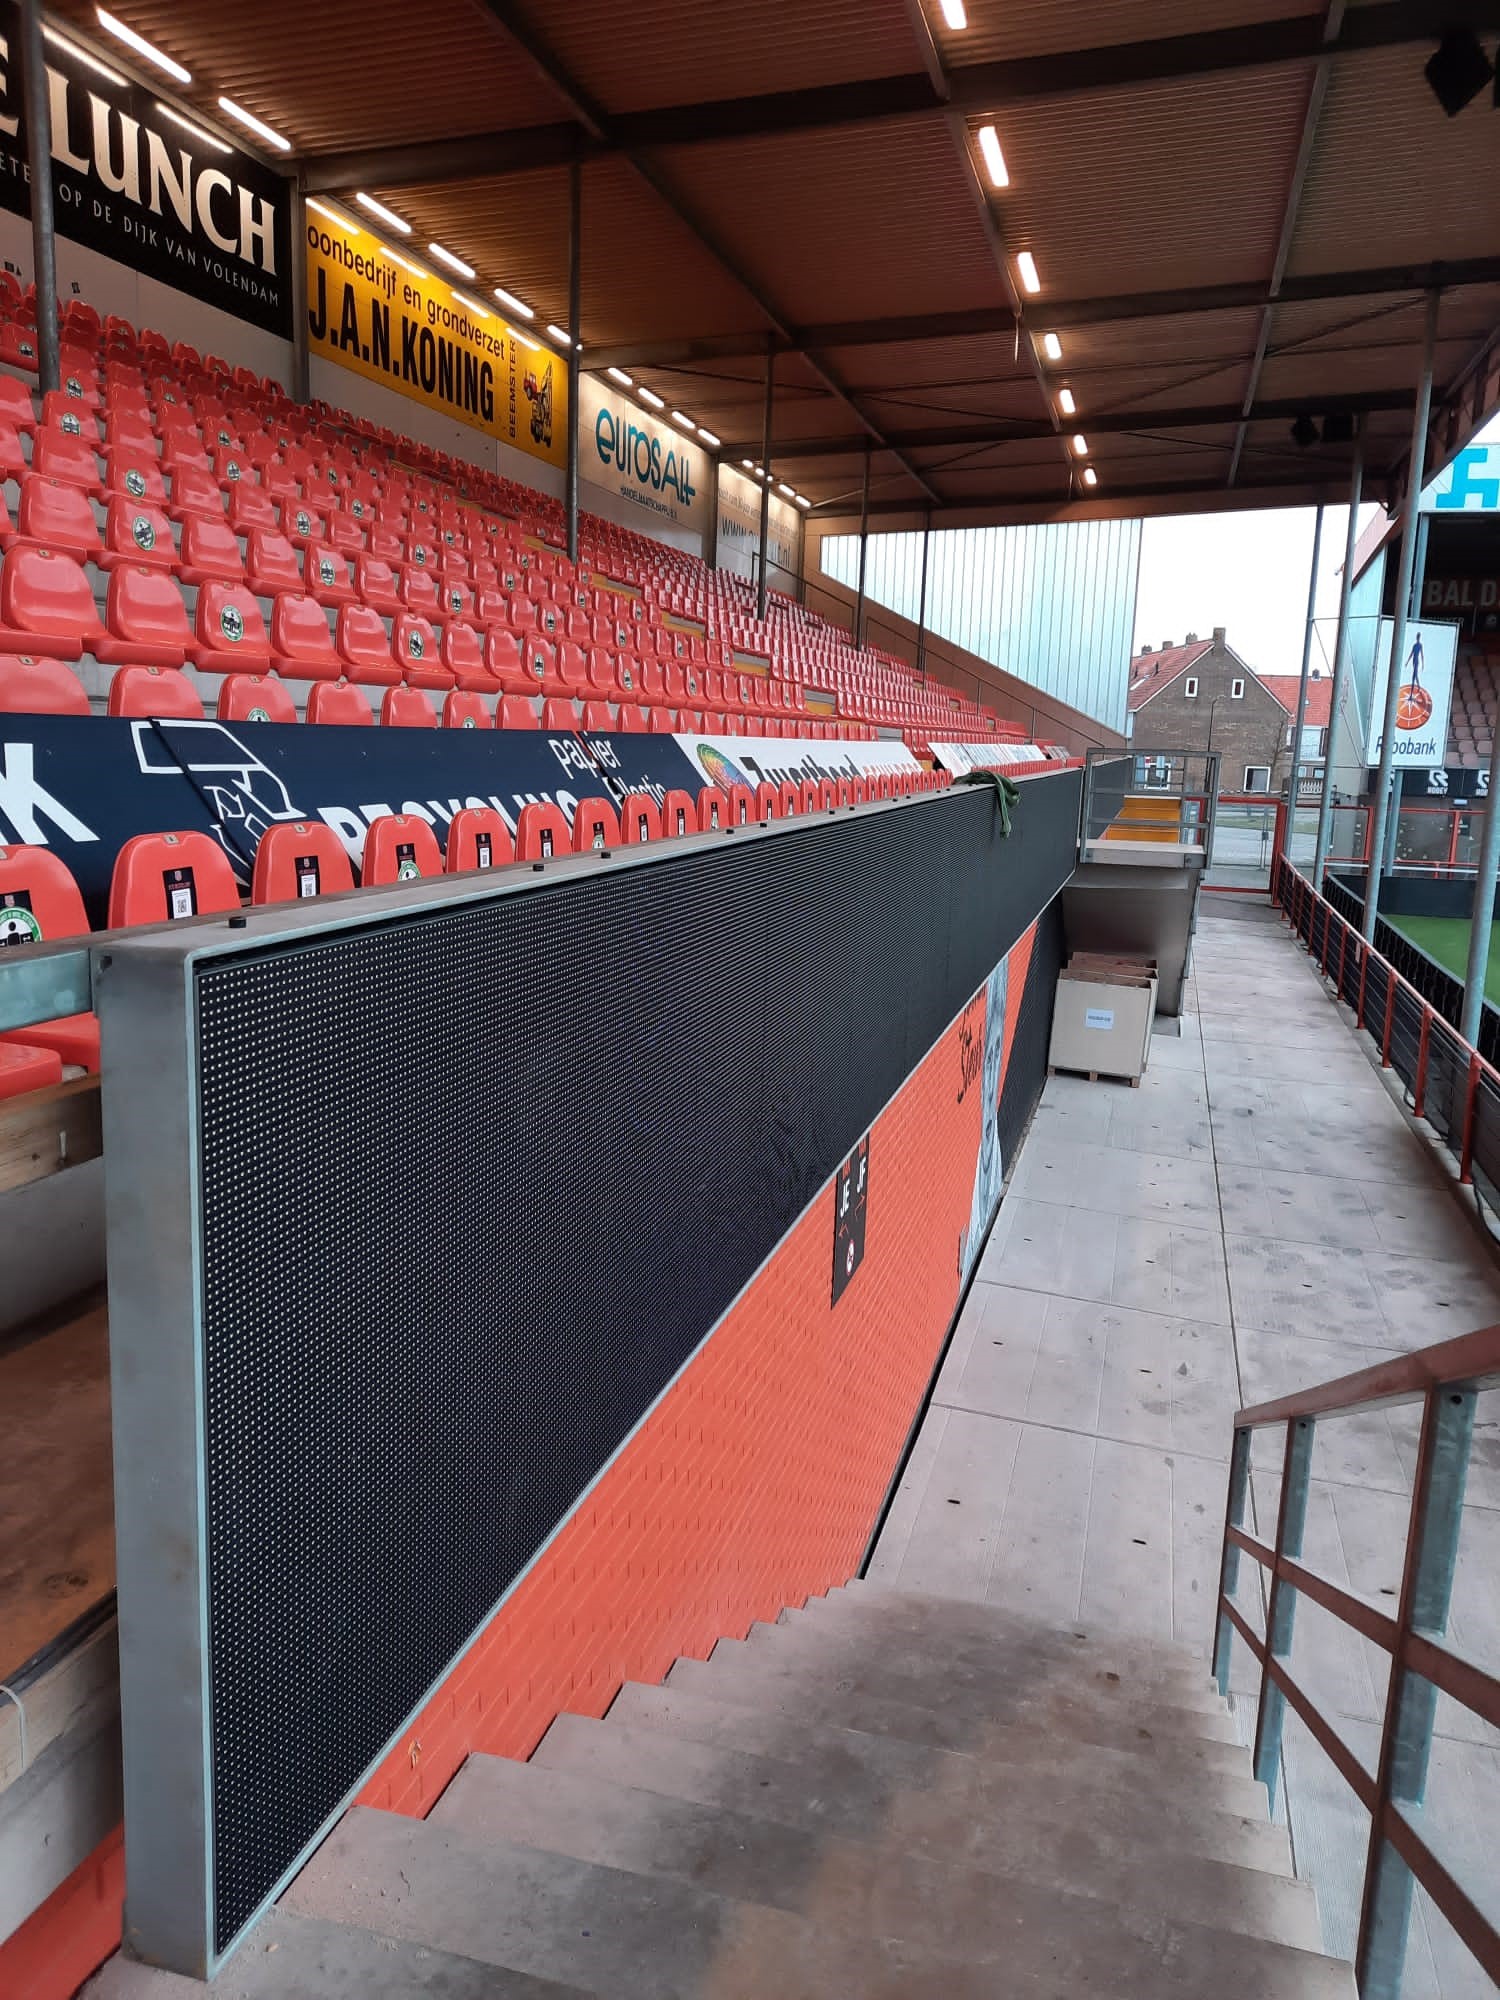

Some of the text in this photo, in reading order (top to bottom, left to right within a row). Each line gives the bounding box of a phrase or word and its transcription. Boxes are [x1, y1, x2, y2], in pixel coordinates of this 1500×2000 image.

[45, 65, 277, 276] LUNCH
[59, 184, 82, 208] OP
[93, 200, 113, 224] DE
[124, 216, 158, 247] DIJK
[165, 238, 196, 267] VAN
[204, 259, 279, 306] VOLENDAM
[404, 285, 421, 311] en
[428, 299, 505, 360] grondverzet
[509, 340, 517, 439] BEEMSTER
[1376, 735, 1437, 755] Rbobank
[840, 1178, 850, 1218] JE
[857, 1155, 867, 1194] JF
